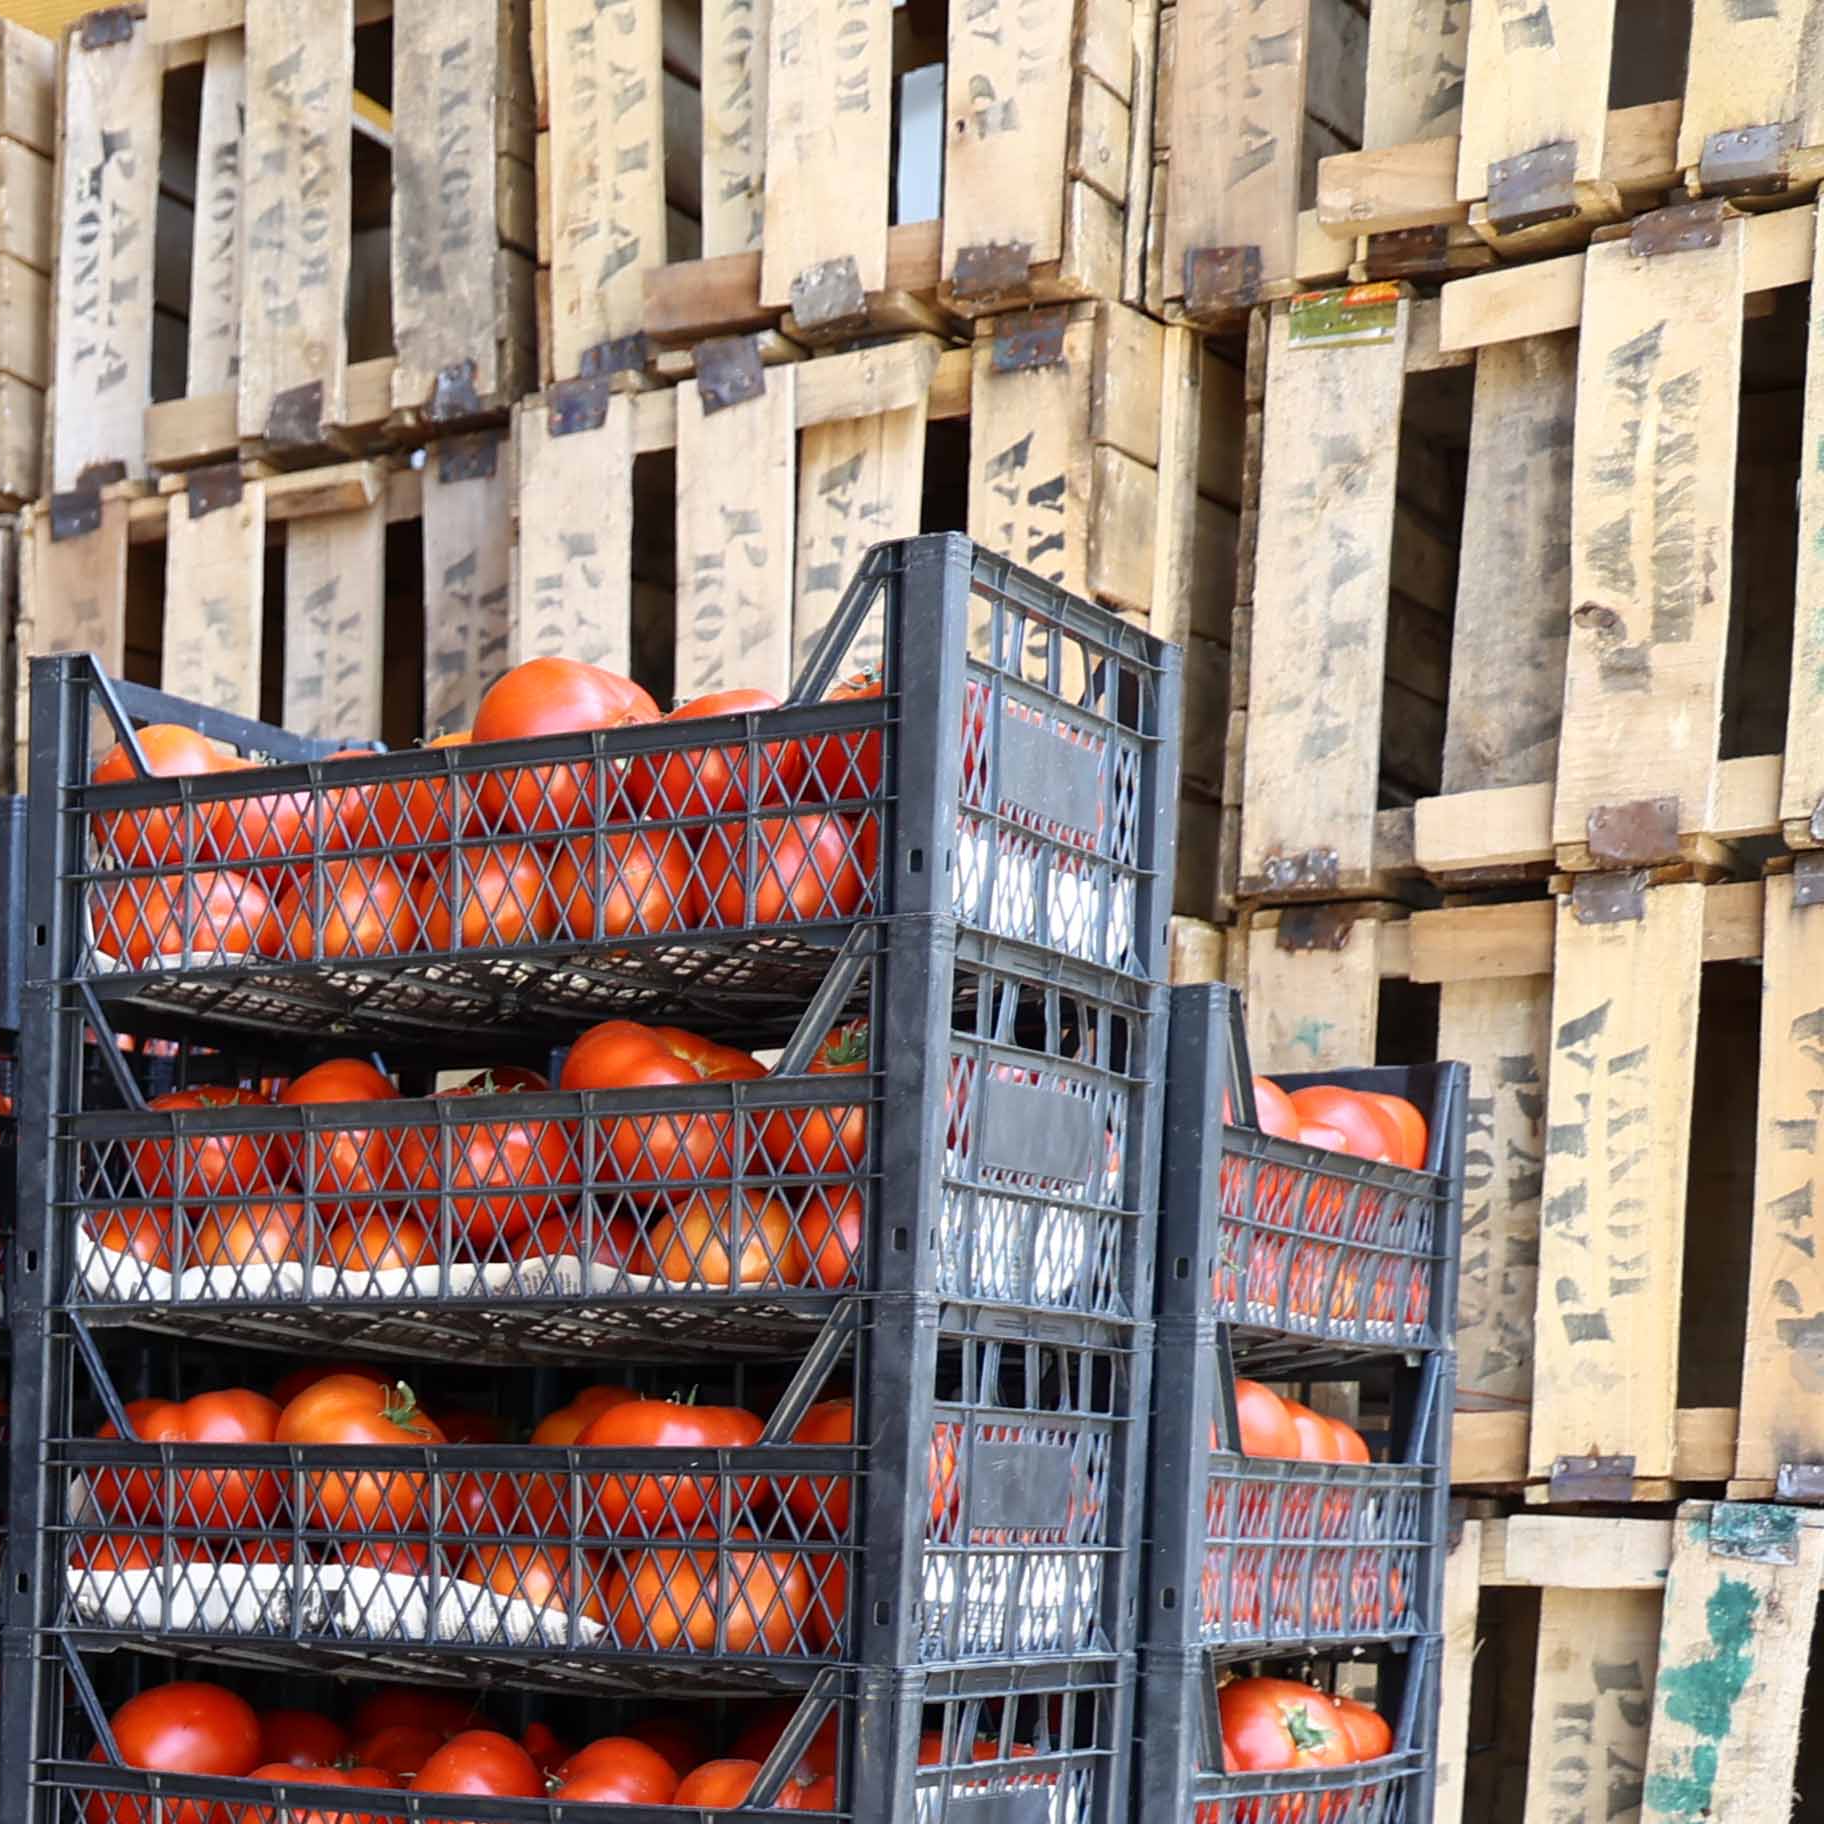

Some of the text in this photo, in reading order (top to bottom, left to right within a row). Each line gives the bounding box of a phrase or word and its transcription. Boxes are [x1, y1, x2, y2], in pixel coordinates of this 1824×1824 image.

[95, 128, 140, 394] PALA
[207, 140, 241, 341] KONYA
[249, 45, 306, 328] PALA
[298, 84, 330, 290] KONYA
[437, 38, 473, 253] KONYA
[1475, 1054, 1544, 1380] PALA
[1544, 998, 1614, 1345] PALA
[1606, 1044, 1651, 1296] KONYA
